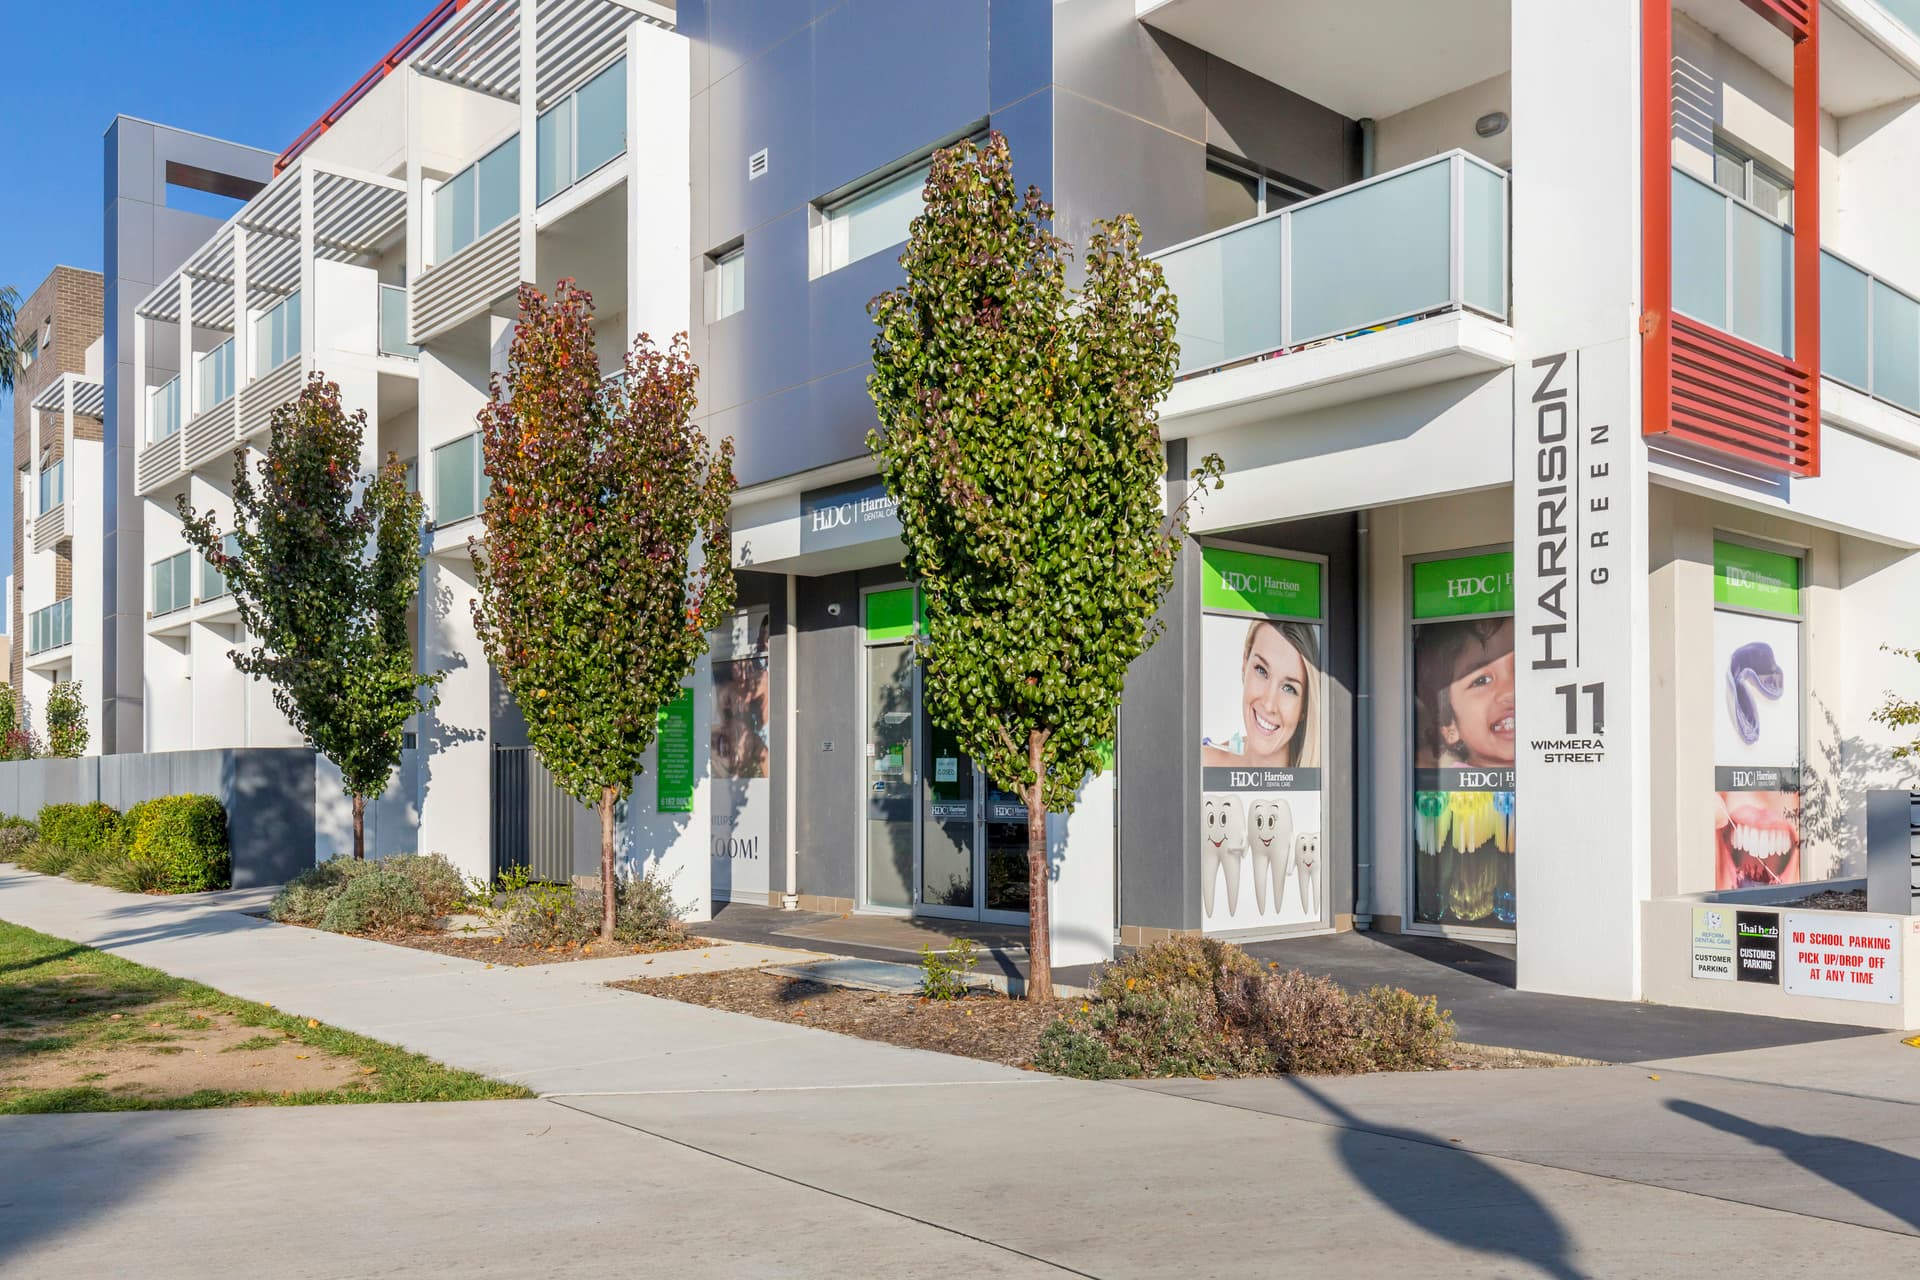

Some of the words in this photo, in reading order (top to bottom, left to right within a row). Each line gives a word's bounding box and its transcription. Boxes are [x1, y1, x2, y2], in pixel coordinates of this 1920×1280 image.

[1531, 351, 1567, 670] HARRISON
[1590, 424, 1609, 585] GREEN
[812, 503, 851, 532] HDC
[864, 510, 885, 522] DENTAL
[1221, 571, 1257, 593] HDC
[1264, 576, 1300, 591] Harrison
[1448, 576, 1495, 598] HDC
[1555, 682, 1604, 735] 11
[1531, 739, 1604, 750] WIMMERA
[1544, 753, 1605, 763] STREET
[1230, 772, 1259, 787] HDC
[1264, 771, 1294, 781] Harrison
[1459, 772, 1498, 787] HDC
[1733, 771, 1754, 787] HDC
[1738, 923, 1757, 933] Thai
[1758, 925, 1779, 935] herb
[1792, 931, 1805, 944] NO
[1809, 933, 1845, 947] SCHOOL
[1849, 935, 1891, 950] PARKING
[1695, 954, 1732, 963] CUSTOMER
[1740, 948, 1776, 960] CUSTOMER
[1798, 951, 1819, 964] PICK
[1823, 953, 1864, 968] UP/DROP
[1868, 956, 1886, 969] OFF
[1698, 964, 1728, 973] PARKING
[1743, 959, 1773, 970] PARKING
[1810, 968, 1821, 980] AT
[1825, 969, 1845, 982] ANY
[1850, 971, 1874, 984] TIME
